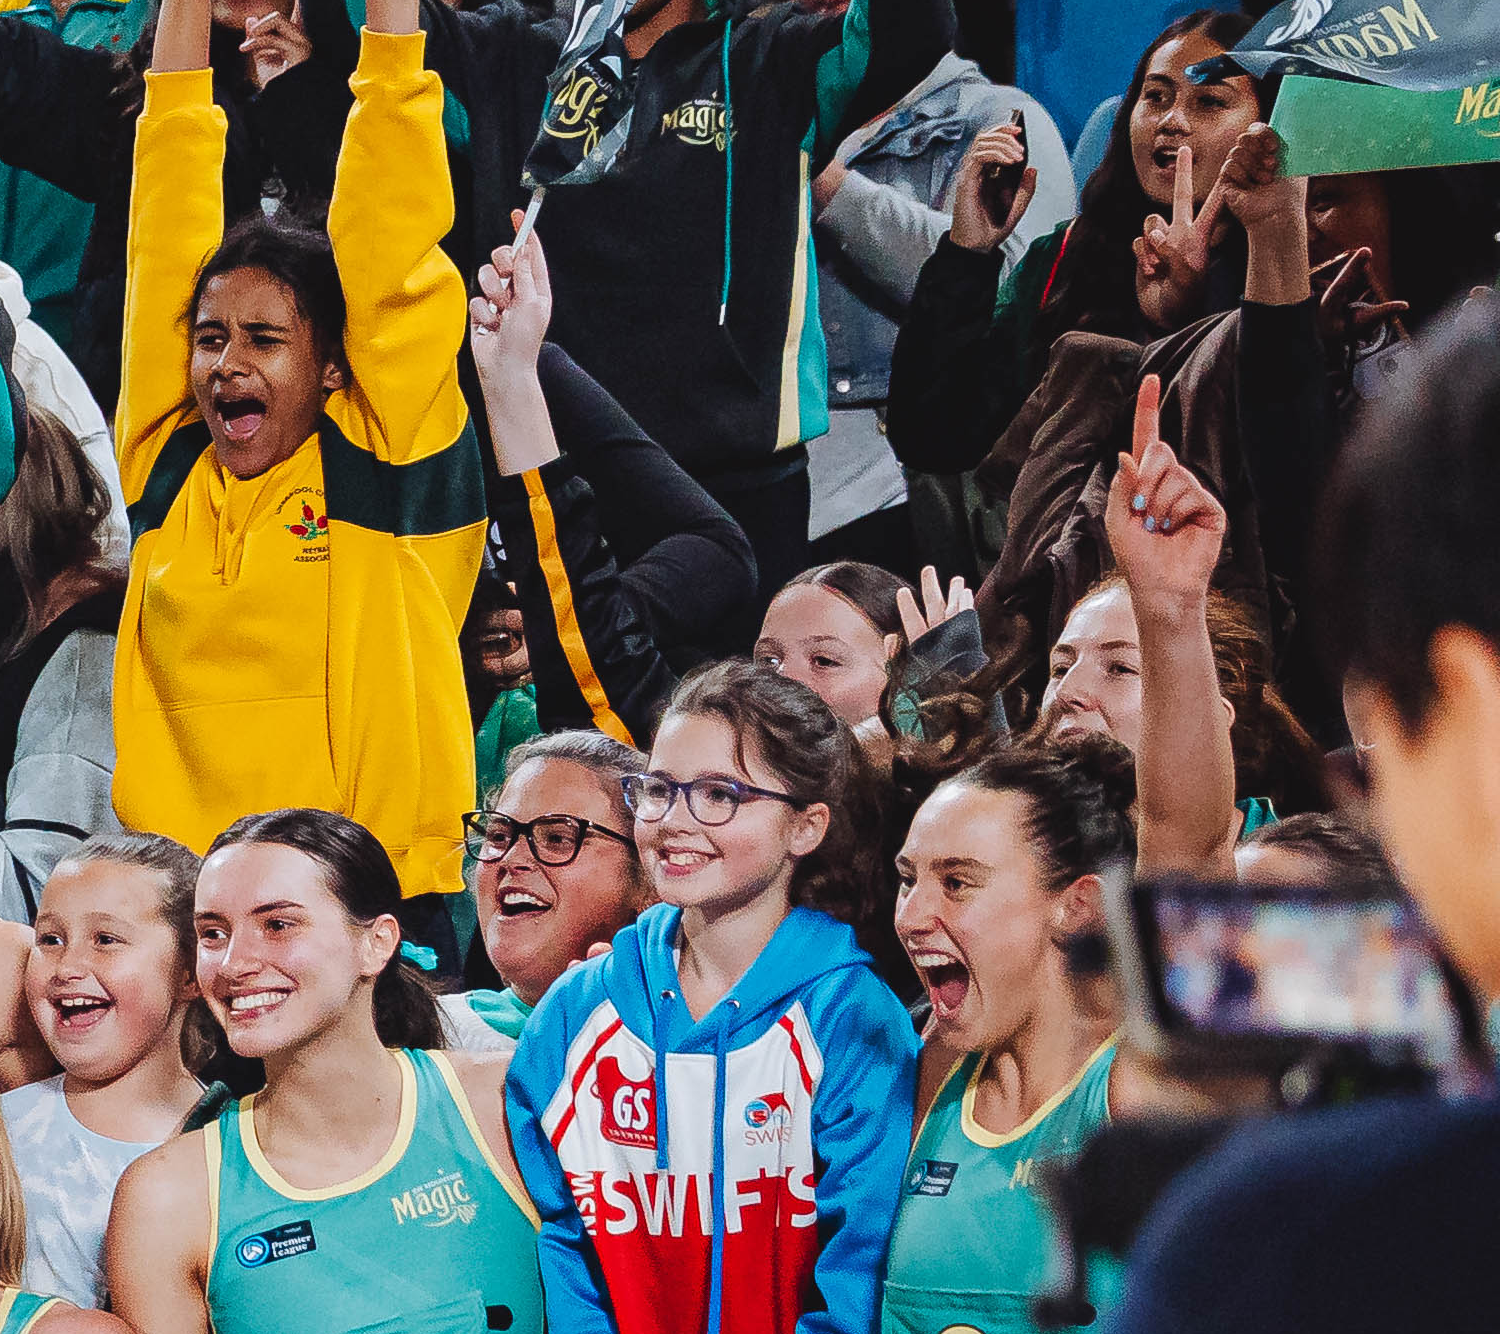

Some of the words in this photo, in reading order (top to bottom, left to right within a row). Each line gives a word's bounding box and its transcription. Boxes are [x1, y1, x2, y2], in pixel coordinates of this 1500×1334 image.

[613, 1085, 651, 1131] GS
[390, 1179, 470, 1225] Magic
[271, 1235, 312, 1250] Premier
